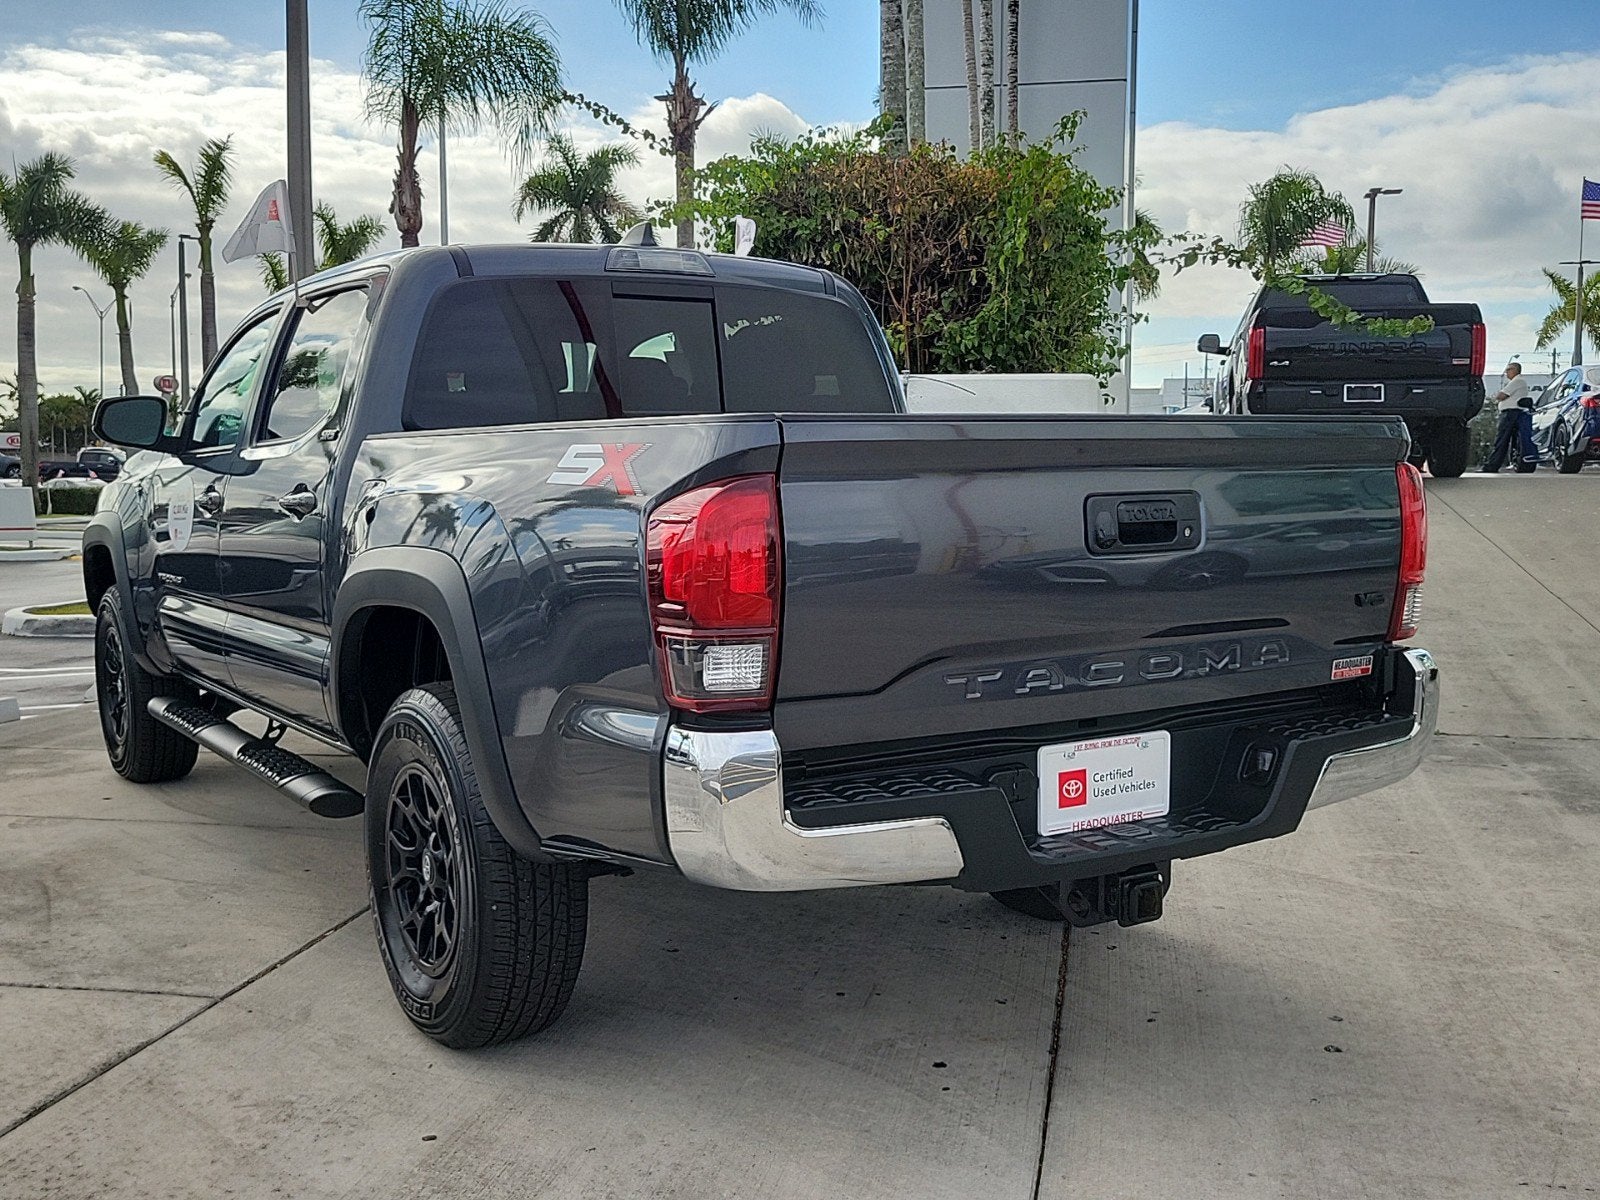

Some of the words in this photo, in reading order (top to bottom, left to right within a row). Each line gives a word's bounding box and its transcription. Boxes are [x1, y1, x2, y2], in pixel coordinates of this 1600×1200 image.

[1126, 507, 1175, 521] TOYOTA
[943, 639, 1291, 700] TACOMA
[1100, 740, 1112, 749] FROM
[1113, 738, 1121, 746] THE
[1093, 767, 1133, 782] Certified
[1093, 785, 1117, 798] Used
[1119, 781, 1155, 794] Vehicles
[1073, 811, 1143, 831] HEADQUARTER
